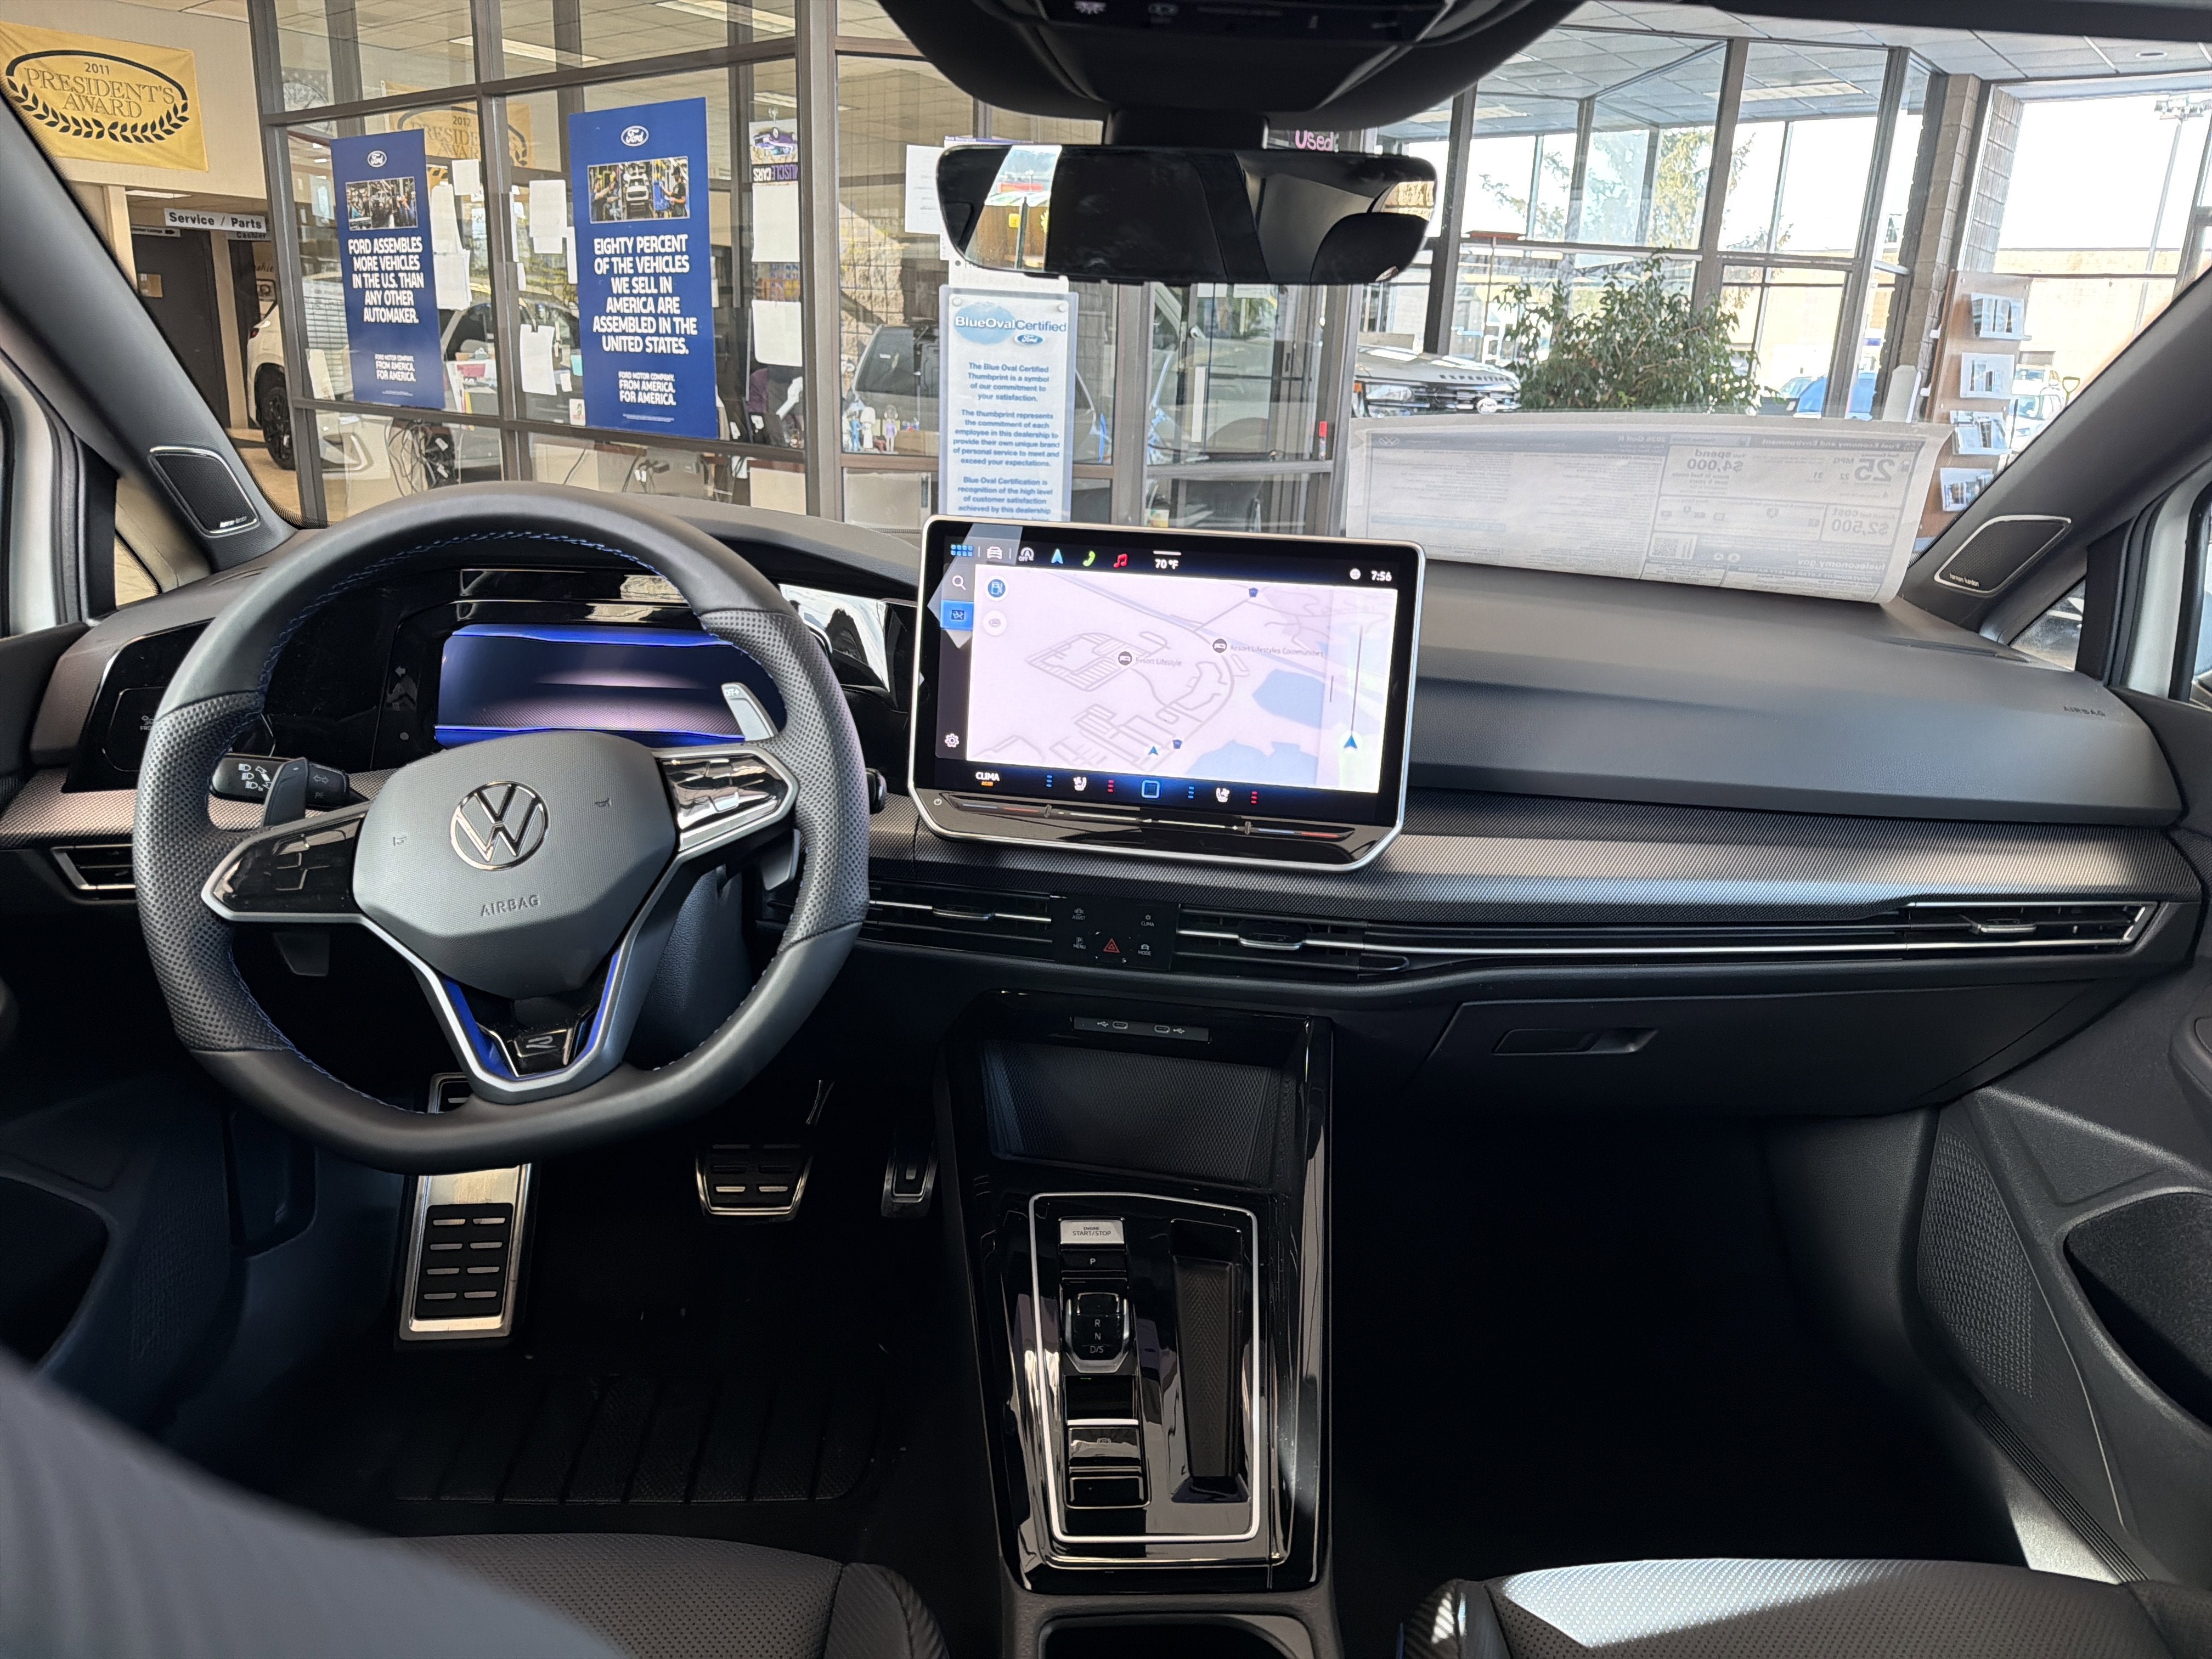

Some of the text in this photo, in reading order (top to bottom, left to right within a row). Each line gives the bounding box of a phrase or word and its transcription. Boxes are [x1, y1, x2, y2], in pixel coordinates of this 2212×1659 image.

[84, 62, 110, 75] 2011
[24, 67, 175, 105] PRESIDENT'S
[63, 93, 142, 119] AWARD
[453, 116, 471, 127] 2012
[623, 127, 646, 145] Ford
[1295, 130, 1334, 151] Used
[369, 152, 385, 166] Ford
[169, 212, 262, 229] Service / Parts
[348, 236, 423, 255] FORD ASSEMBLES
[594, 234, 688, 255] EIGHTY PERCENT
[353, 255, 420, 271] MORE VEHICLES
[594, 255, 690, 274] OF THE VEHICLES
[352, 272, 425, 289] IN THE U.S. THAN
[611, 276, 672, 294] WE SELL IN
[365, 290, 414, 306] ANY OTHER
[606, 297, 680, 314] AMERICA ARE
[363, 307, 419, 323] AUTOMAKER.
[593, 315, 698, 335] ASSEMBLED IN THE
[602, 335, 689, 354] UNITED STATES.
[376, 360, 415, 371] FROM AMERICA.
[1019, 365, 1049, 373] Certified
[376, 370, 416, 382] FOR AMERICA.
[968, 373, 1008, 381] Thumbprint
[619, 379, 675, 393] FROM AMERICA.
[619, 390, 676, 405] FOR AMERICA.
[996, 393, 1038, 402] satisfaction.
[1013, 431, 1050, 439] dealership
[991, 505, 999, 514] by
[1015, 506, 1051, 515] dealership
[1155, 558, 1167, 569] 70
[1371, 571, 1392, 582] 7:56
[975, 771, 1000, 781] CLIMA
[481, 894, 541, 917] AIRBAG
[1094, 1319, 1101, 1327] R
